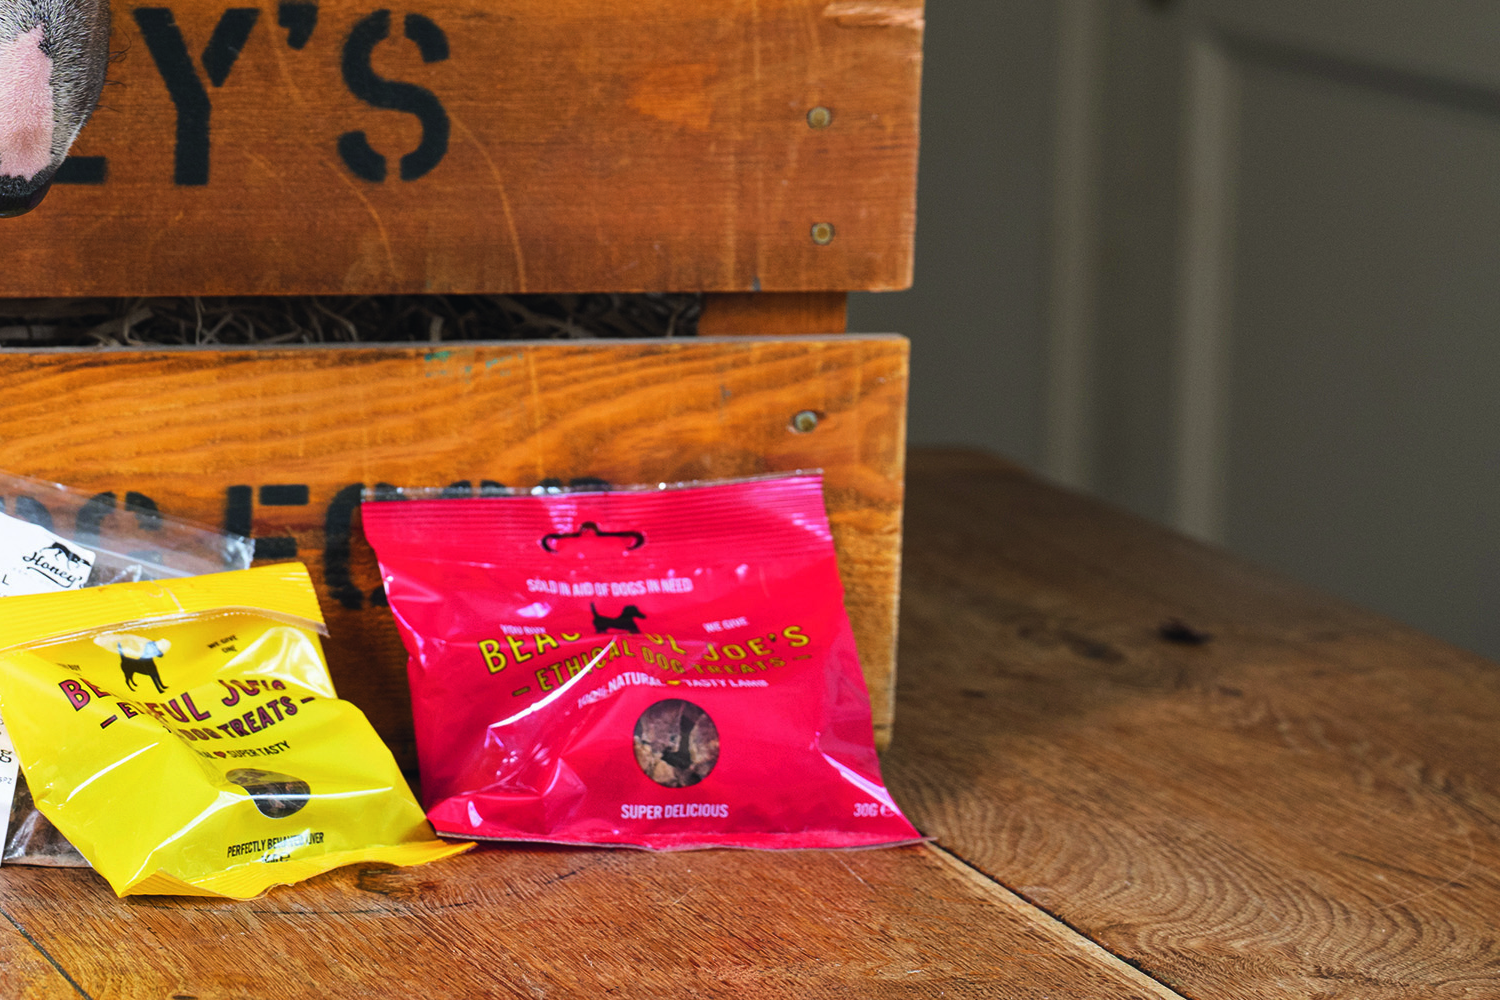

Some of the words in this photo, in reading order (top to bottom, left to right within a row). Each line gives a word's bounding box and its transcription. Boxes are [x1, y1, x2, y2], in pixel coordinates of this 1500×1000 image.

[526, 578, 558, 595] SOLD
[558, 582, 572, 597] IN
[572, 582, 594, 597] AID
[594, 582, 610, 597] OF
[610, 580, 646, 597] DOGS
[646, 579, 660, 594] IN
[660, 577, 695, 594] NEED
[702, 621, 723, 634] WE
[721, 616, 750, 630] GIVE
[702, 625, 811, 662] JOE'S
[534, 639, 636, 692] ETHICAL
[641, 645, 686, 674] DOG
[691, 656, 787, 675] TREATS
[607, 671, 668, 694] NATURAL
[680, 678, 728, 688] TASTY
[728, 678, 770, 689] LAMB
[216, 695, 299, 739] TREATS
[227, 748, 257, 760] SUPER
[257, 739, 292, 758] TASTY
[620, 803, 663, 820] SUPER
[664, 803, 730, 819] DELICIOUS
[853, 802, 879, 818] 30G
[227, 838, 266, 859] PERFECTLY
